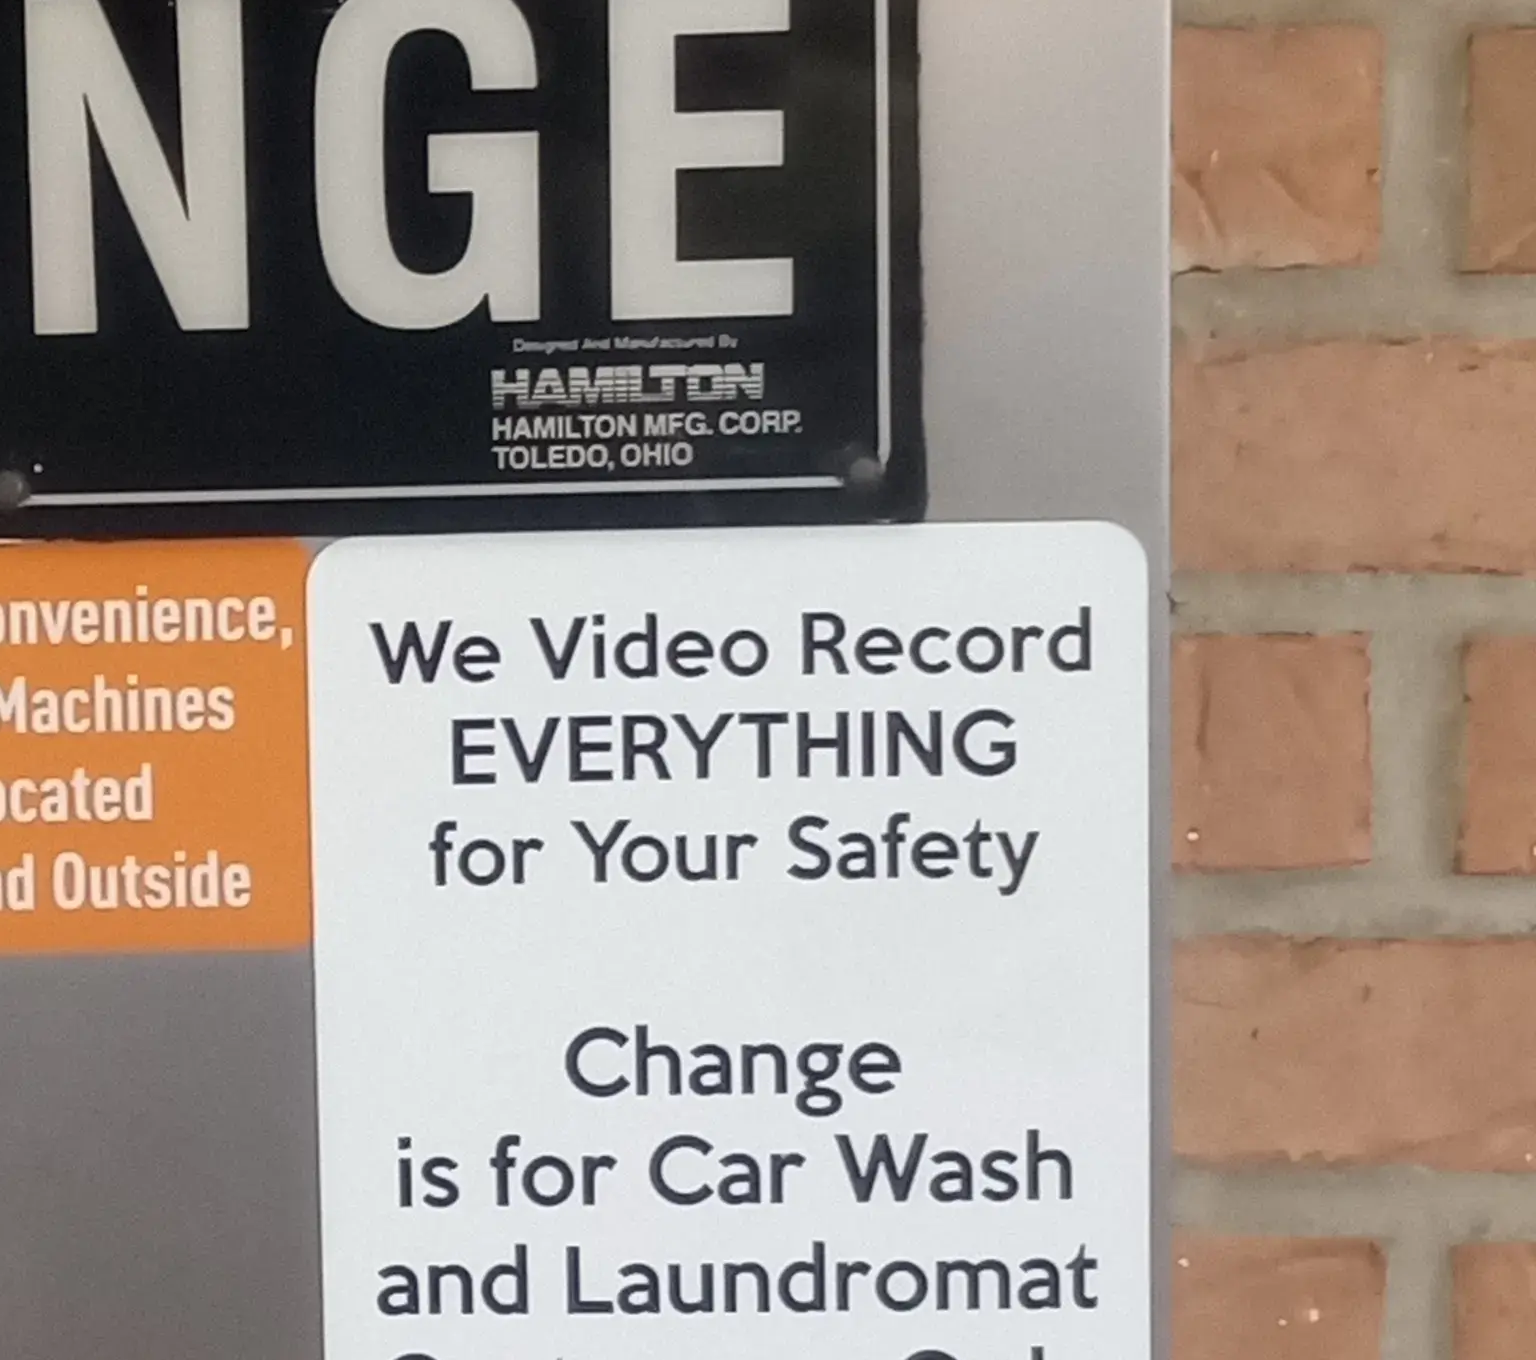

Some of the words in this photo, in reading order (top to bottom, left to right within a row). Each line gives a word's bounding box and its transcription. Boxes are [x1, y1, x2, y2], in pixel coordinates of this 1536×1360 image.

[490, 363, 764, 410] HAMILTON
[491, 443, 615, 471] TOLEDO,
[620, 441, 694, 467] OHIO
[492, 413, 638, 441] HAMILTON
[643, 411, 714, 437] MFG.
[718, 409, 803, 435] CORP.
[369, 619, 501, 685] We
[529, 612, 769, 680] Video
[801, 606, 1092, 675] Record
[451, 708, 1017, 785] EVERYTHING
[53, 849, 252, 910] Outside
[428, 820, 545, 887] for
[570, 819, 759, 883] Your
[787, 812, 1040, 896] Safety
[565, 1024, 902, 1118] Change
[398, 1136, 460, 1208] is
[489, 1134, 618, 1207] for
[649, 1134, 806, 1206] Car
[834, 1128, 1073, 1203] Wash
[376, 1243, 529, 1316] and
[566, 1241, 1098, 1315] Laundromat
